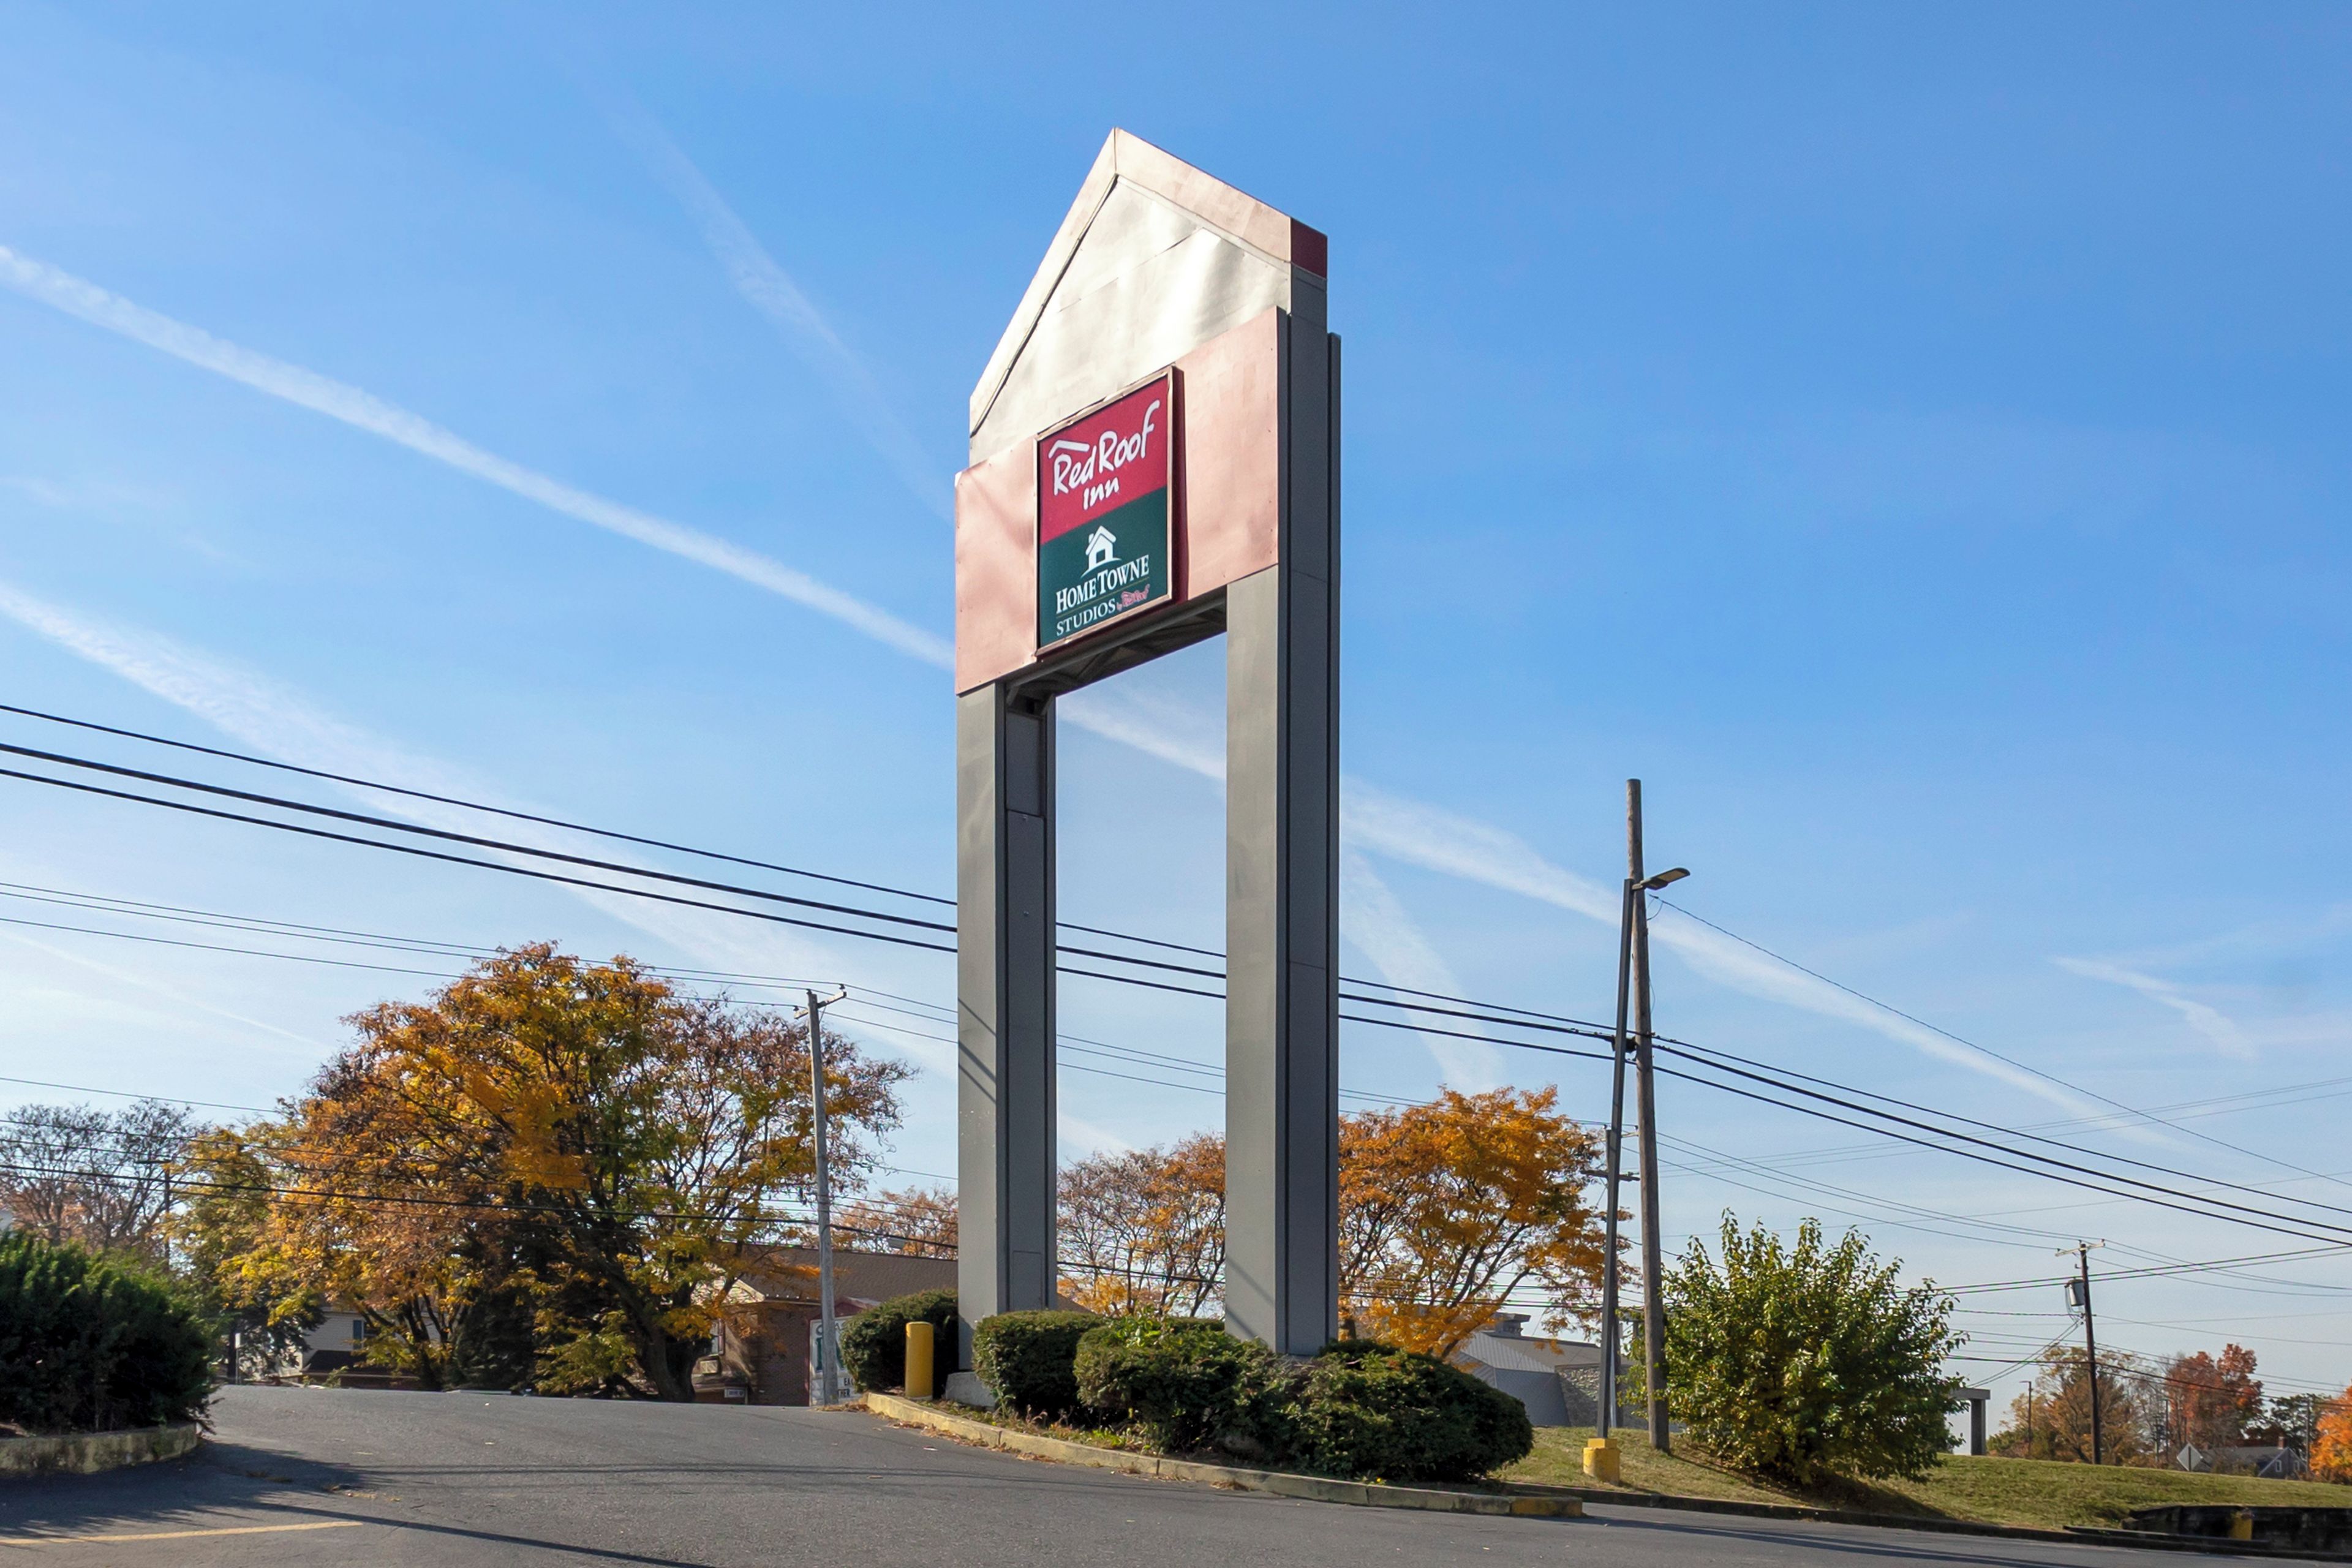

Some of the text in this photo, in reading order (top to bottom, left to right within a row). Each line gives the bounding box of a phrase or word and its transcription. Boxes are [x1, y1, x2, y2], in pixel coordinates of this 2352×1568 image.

[1054, 399, 1161, 496] Red Roof
[1056, 598, 1116, 637] STUDIOS
